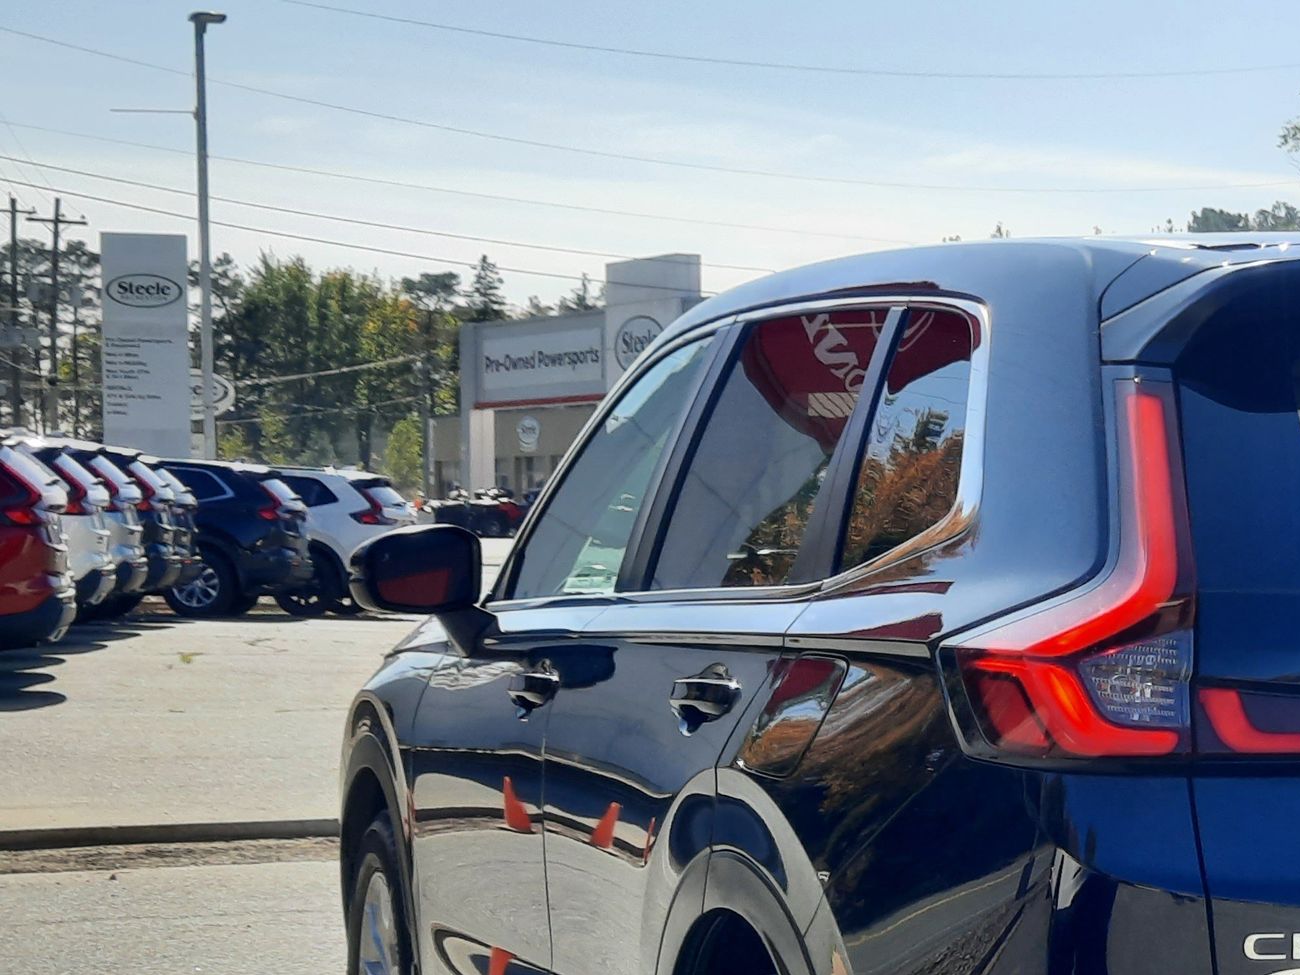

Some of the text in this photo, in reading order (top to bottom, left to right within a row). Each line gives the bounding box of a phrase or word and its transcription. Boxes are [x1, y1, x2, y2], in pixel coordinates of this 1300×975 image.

[117, 281, 171, 296] Steele
[485, 347, 600, 373] Pre-Owned Powersports
